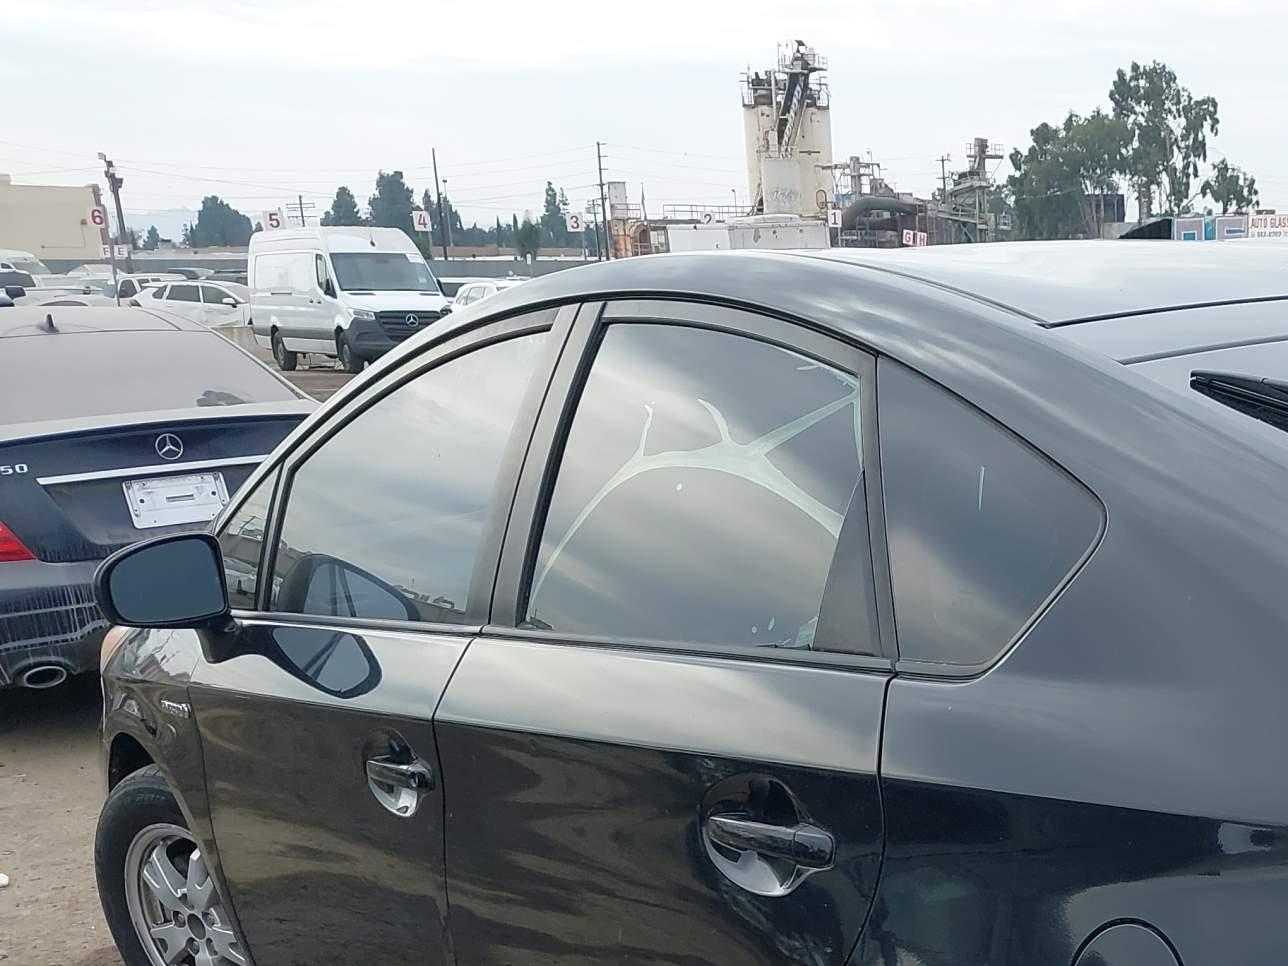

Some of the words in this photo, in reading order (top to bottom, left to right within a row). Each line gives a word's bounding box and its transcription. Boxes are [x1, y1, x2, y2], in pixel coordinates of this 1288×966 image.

[91, 209, 104, 226] 6
[268, 212, 281, 229] 5
[416, 213, 428, 229] 4
[569, 215, 580, 230] 3
[831, 212, 840, 225] 1
[1250, 216, 1268, 229] AUTO
[903, 232, 913, 244] G
[919, 234, 927, 246] H
[117, 247, 125, 256] E
